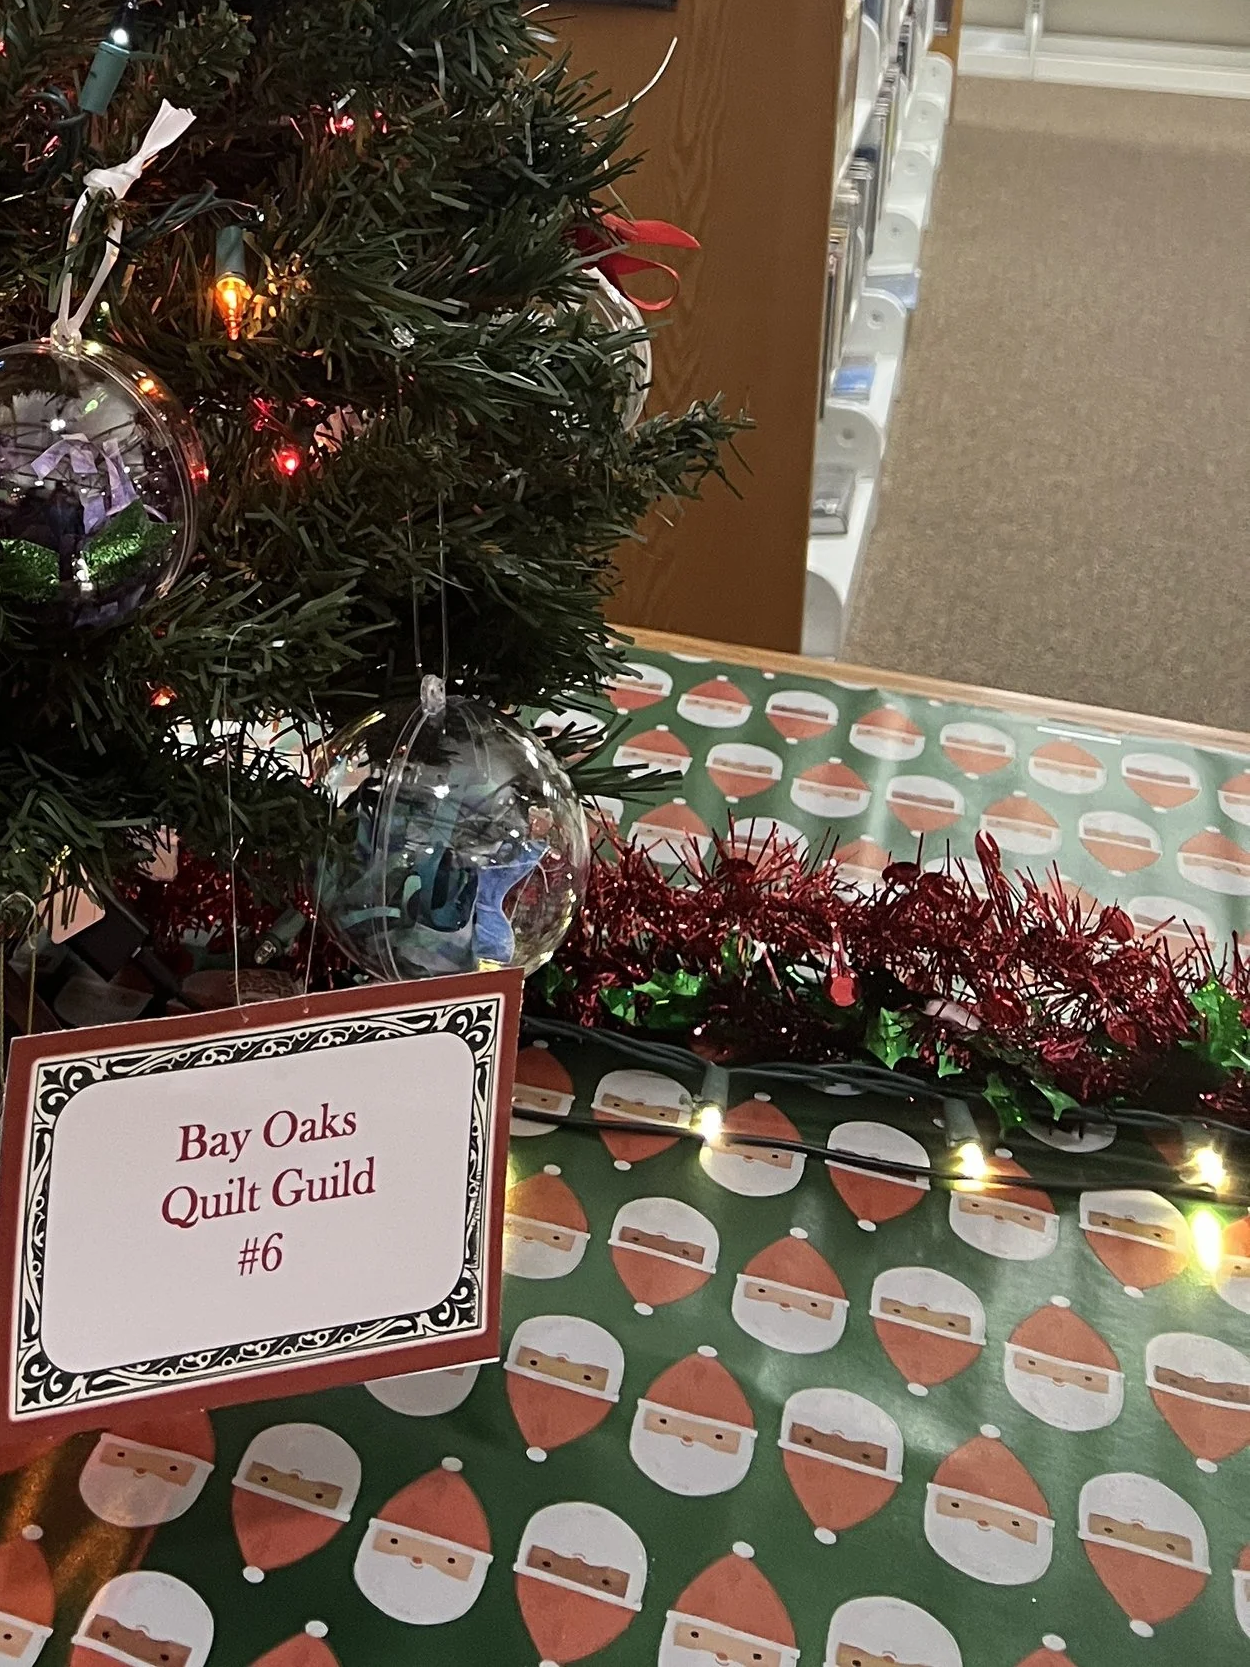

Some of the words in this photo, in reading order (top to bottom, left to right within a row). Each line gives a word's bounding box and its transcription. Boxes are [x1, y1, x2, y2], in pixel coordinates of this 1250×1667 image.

[176, 1122, 251, 1163] Bay
[263, 1103, 358, 1148] Oaks
[161, 1177, 261, 1229] Quilt
[271, 1157, 376, 1208] Guild
[238, 1232, 283, 1276] #6
